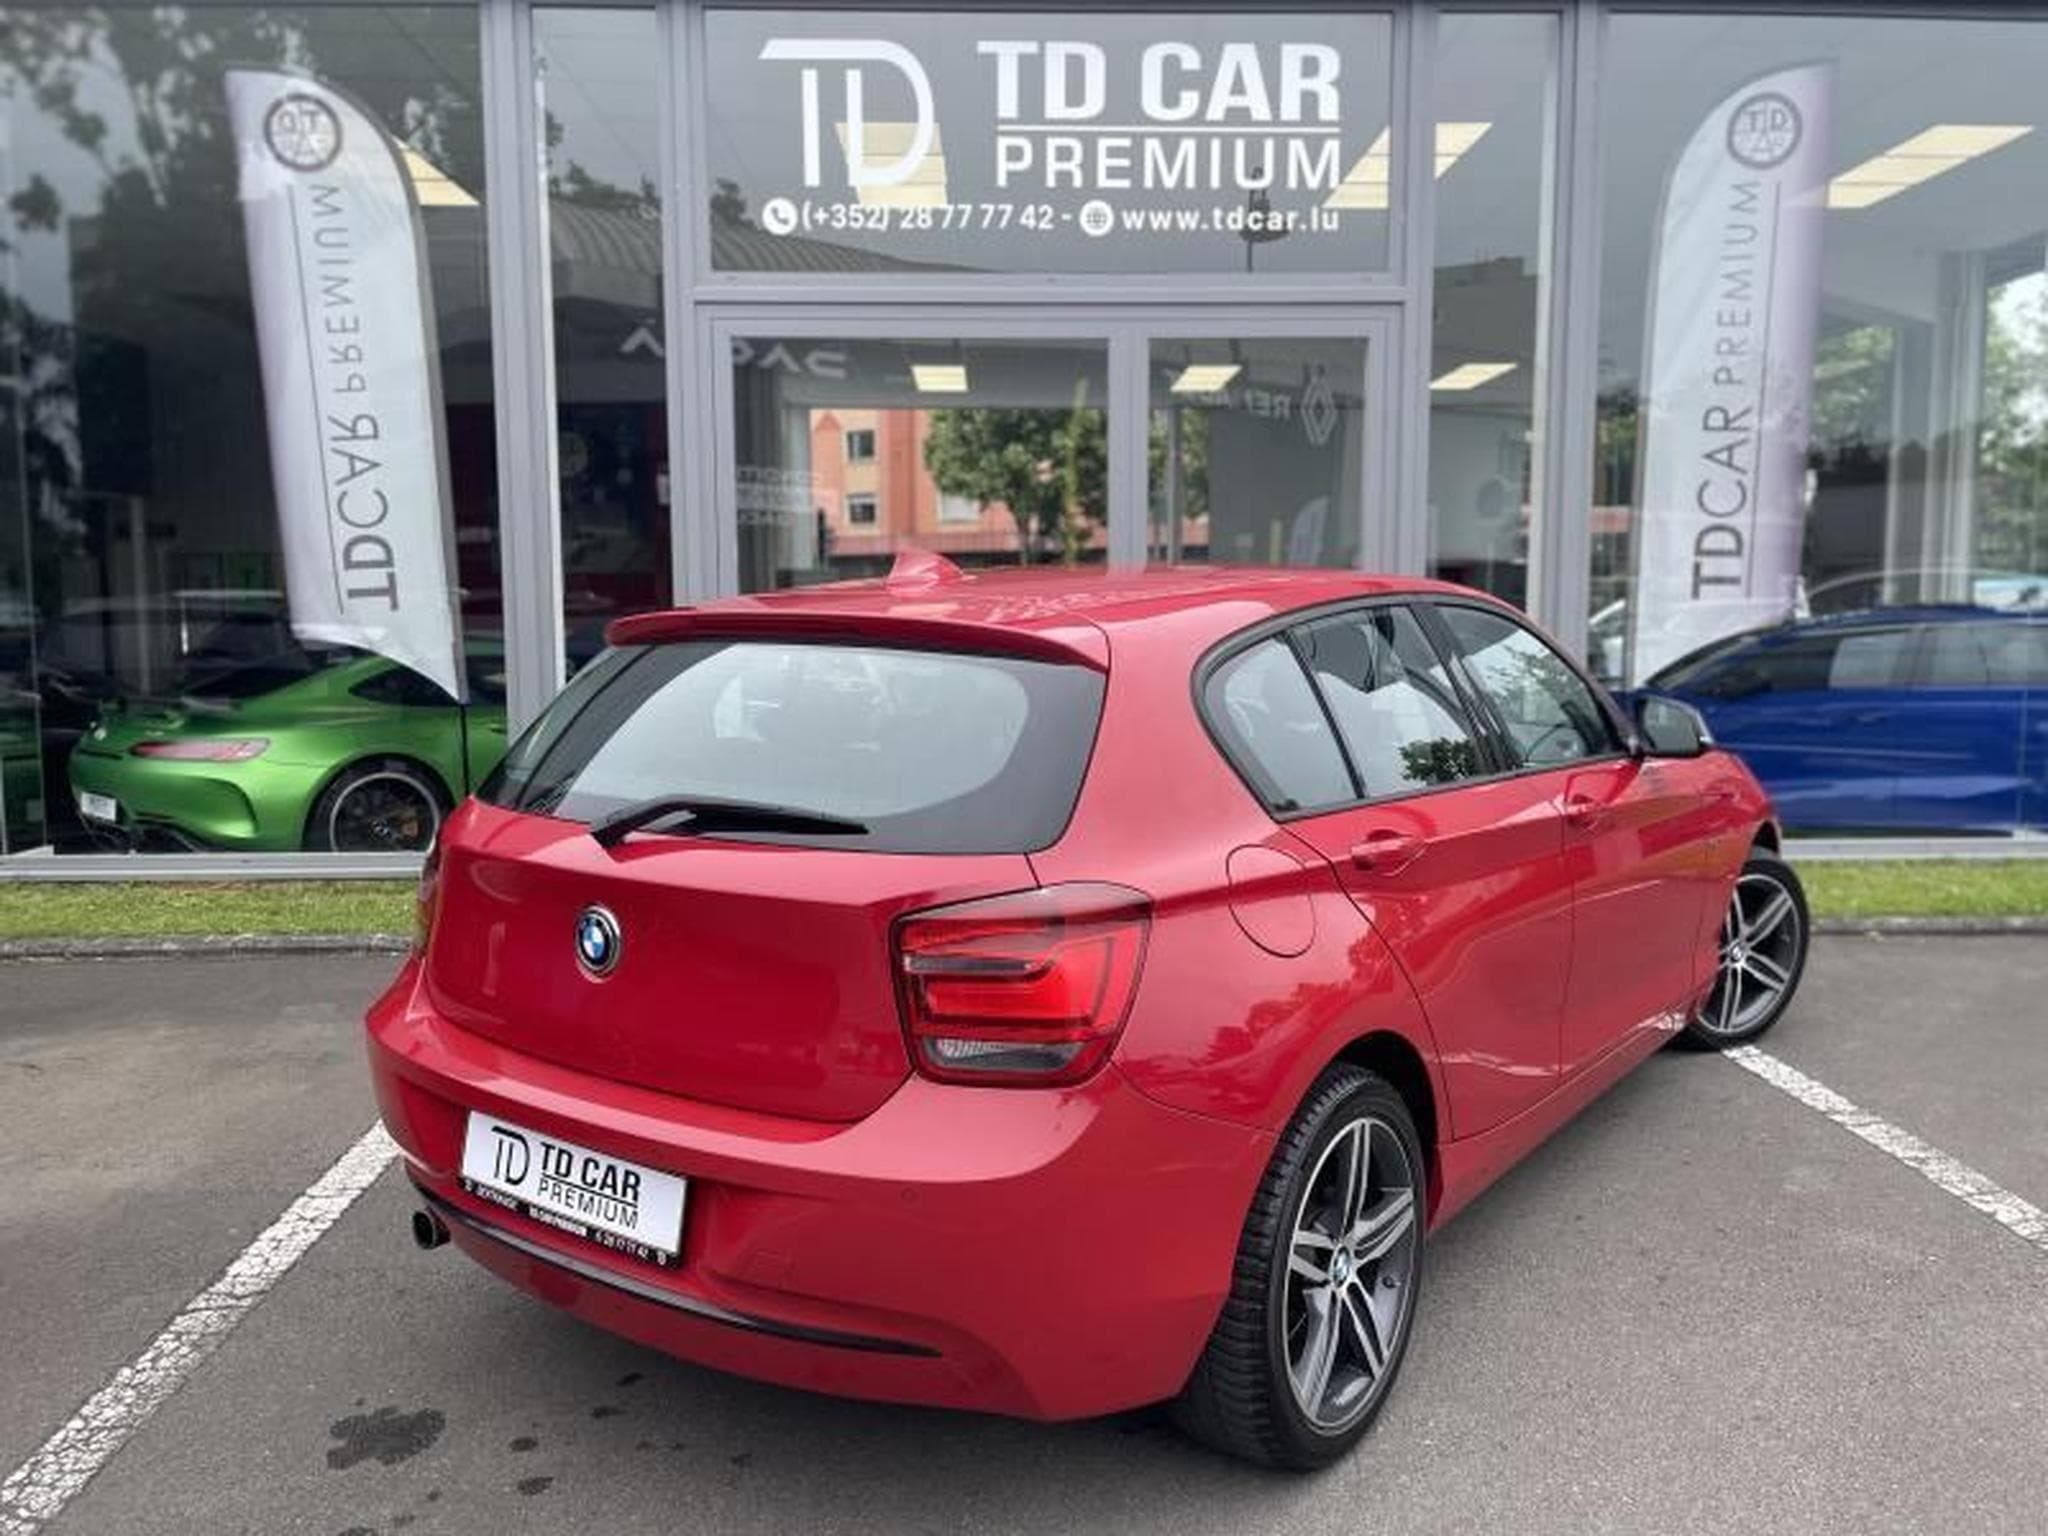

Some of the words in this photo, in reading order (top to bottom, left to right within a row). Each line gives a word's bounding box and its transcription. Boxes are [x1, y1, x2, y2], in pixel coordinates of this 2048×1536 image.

[977, 41, 1106, 119] TD
[1141, 41, 1341, 122] CAR
[996, 138, 1341, 189] PREMIUM
[803, 204, 889, 231] (+352)
[899, 204, 933, 230] 28
[940, 204, 972, 230] 77
[980, 204, 1012, 230] 77
[1020, 203, 1054, 230] 42
[1122, 202, 1340, 231] www.tdcar.lu
[1713, 180, 1762, 387] PREMIUM
[1691, 404, 1753, 602] TDCAR
[540, 1141, 573, 1178] TD
[581, 1158, 641, 1202] CAR
[537, 1176, 639, 1230] PREMIUM
